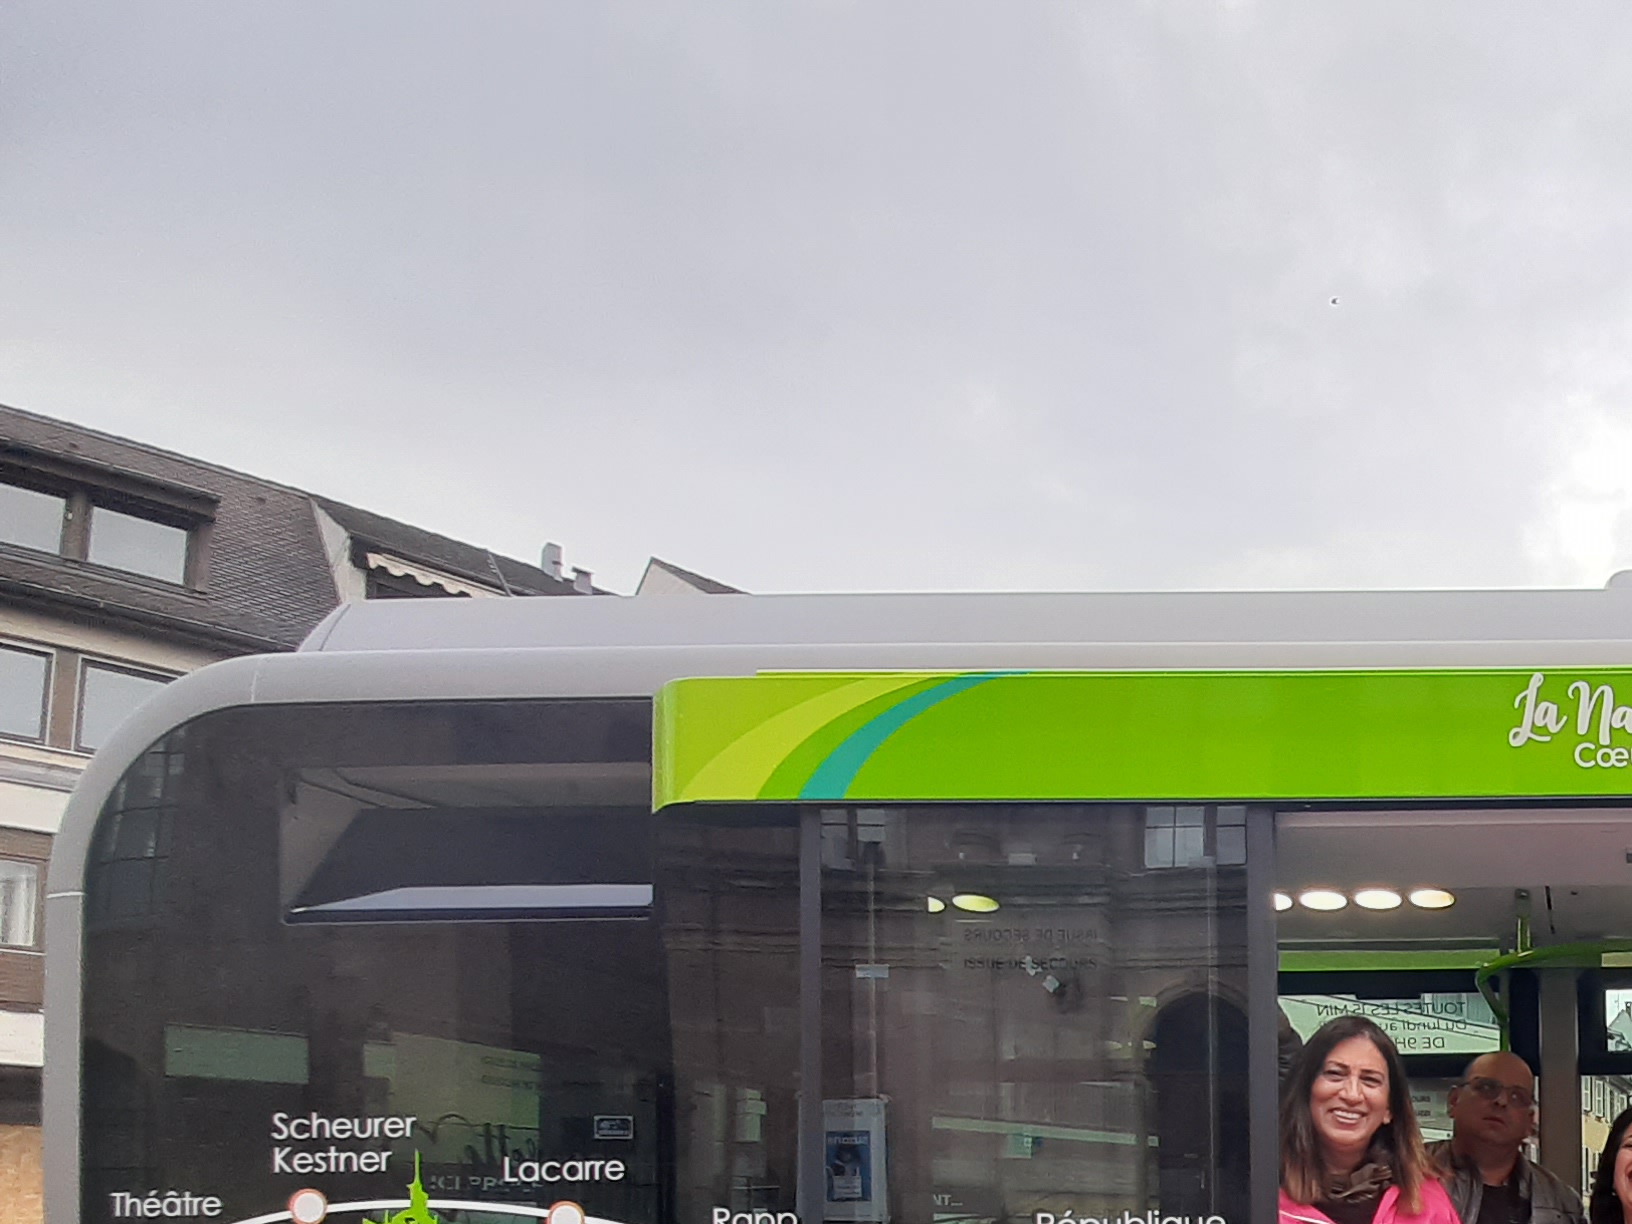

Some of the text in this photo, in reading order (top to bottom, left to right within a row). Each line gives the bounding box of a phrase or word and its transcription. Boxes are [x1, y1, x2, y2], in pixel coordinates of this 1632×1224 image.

[1508, 672, 1568, 747] La
[272, 1111, 416, 1141] Scheurer
[273, 1147, 391, 1174] Kestner
[503, 1156, 626, 1182] Lacarre
[111, 1191, 222, 1219] Théâtre
